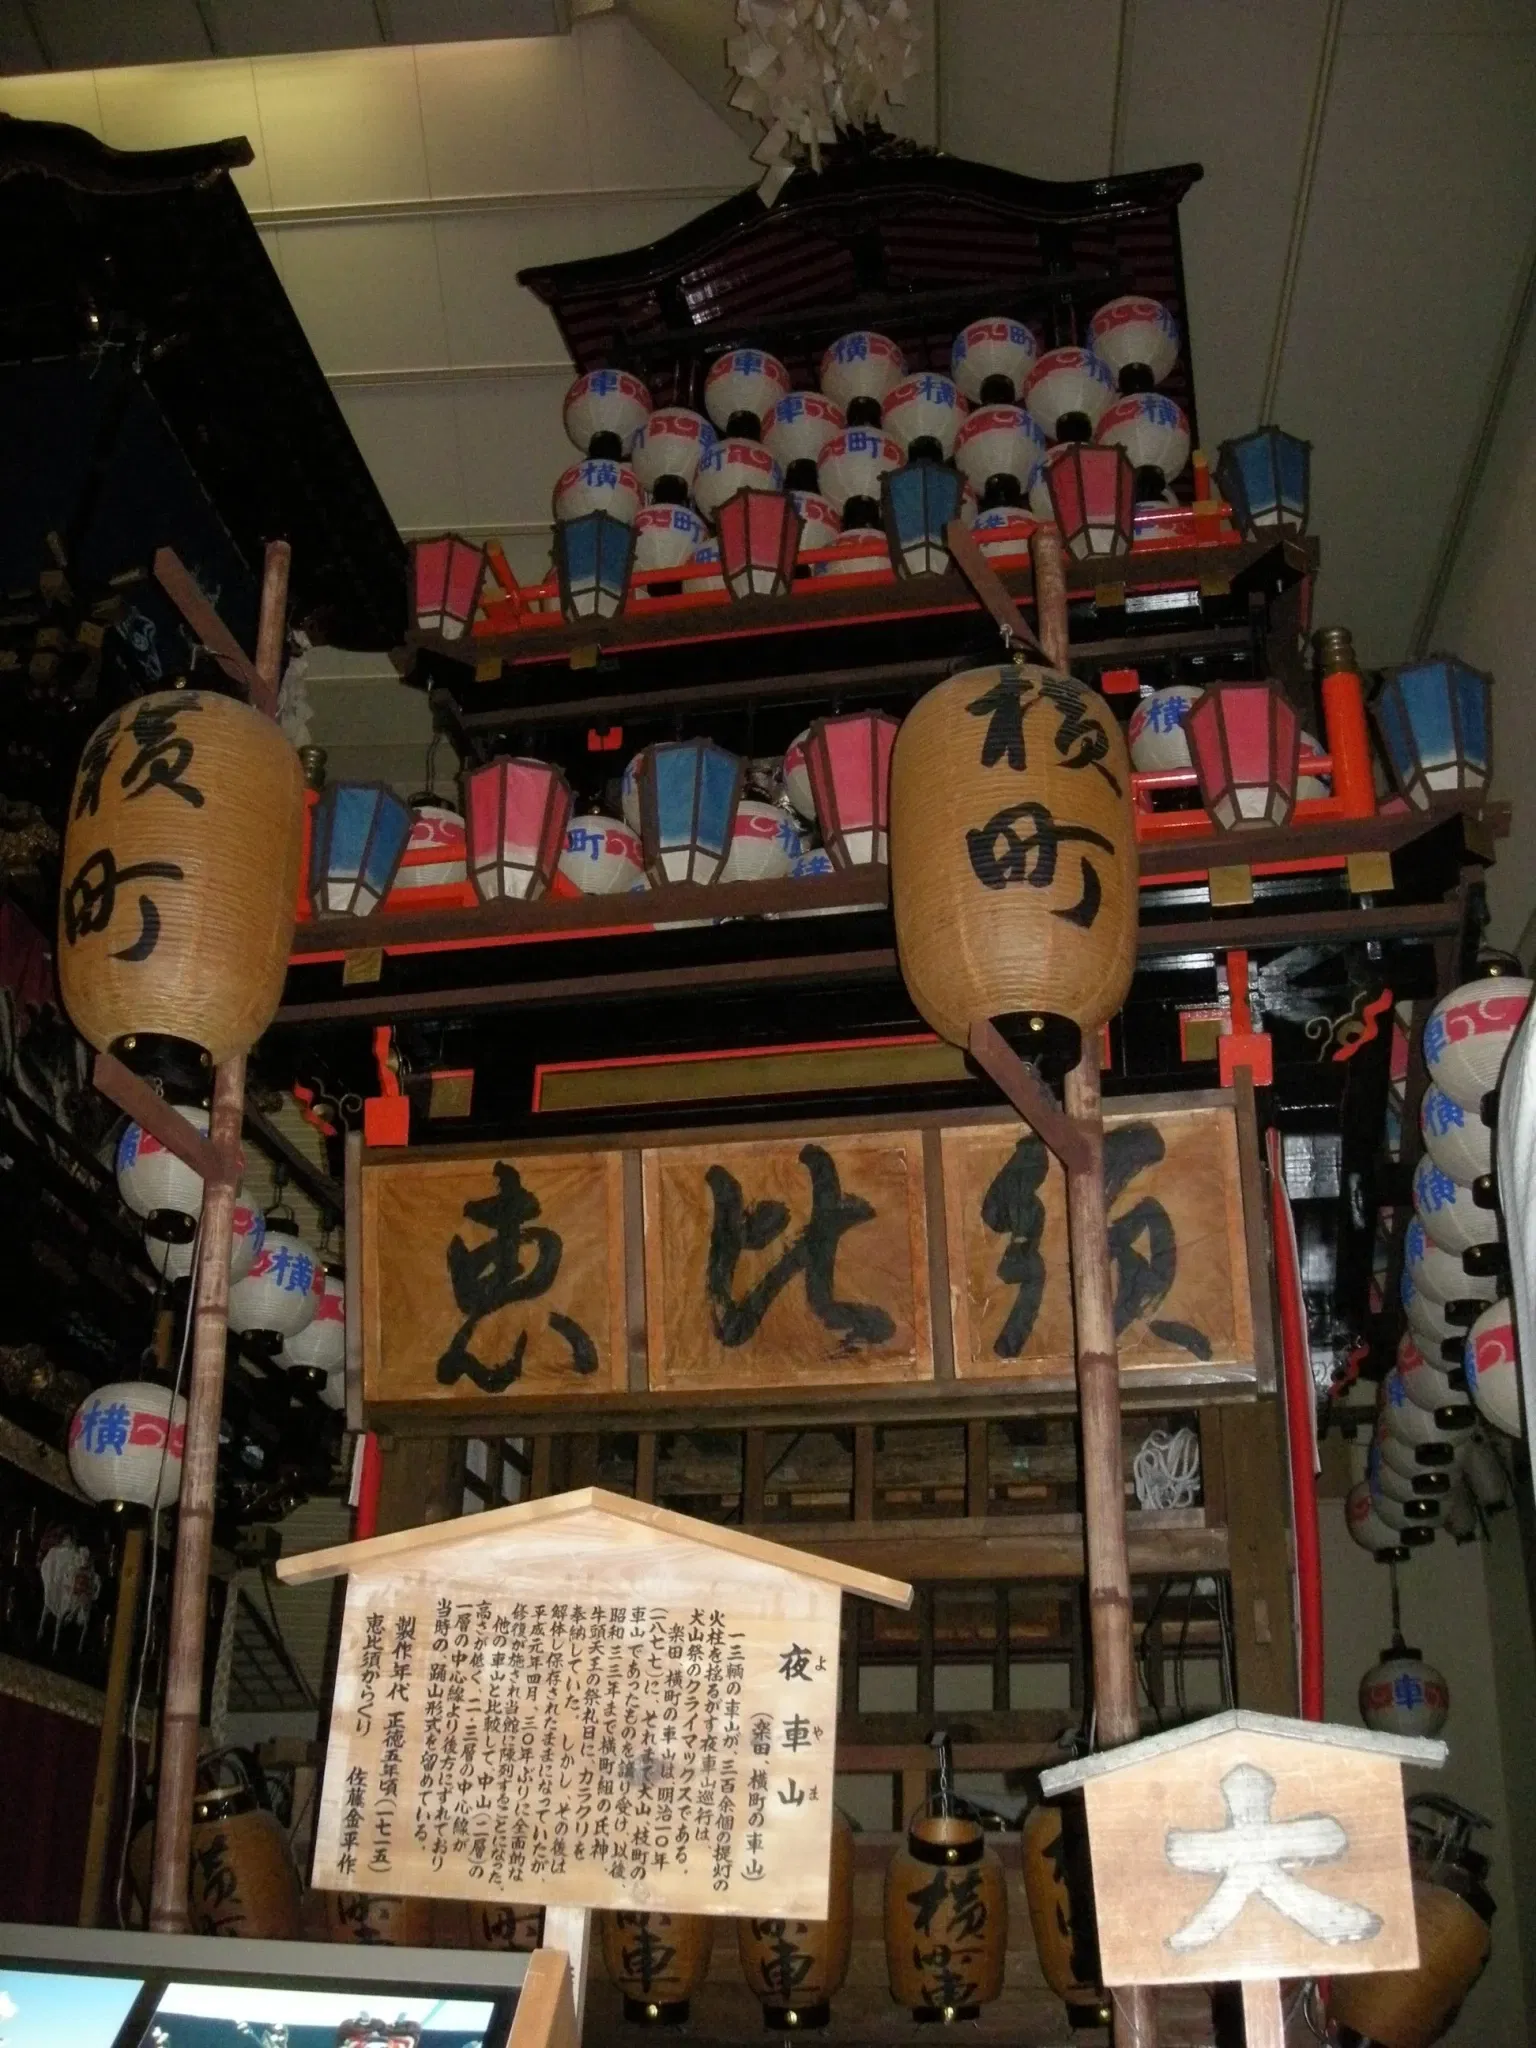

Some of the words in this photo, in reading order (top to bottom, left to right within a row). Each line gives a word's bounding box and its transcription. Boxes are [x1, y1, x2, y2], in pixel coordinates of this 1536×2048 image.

[848, 432, 882, 459] 町
[580, 463, 618, 490] 横
[673, 511, 704, 544] 町
[567, 828, 604, 861] 町
[270, 1246, 315, 1297] 横
[81, 1402, 132, 1456] 横
[356, 1612, 386, 1737] 恵比須からくり
[386, 1615, 416, 1702] 製作年代
[778, 1642, 813, 1807] 夜車山
[336, 1765, 368, 1876] 佐藤金平作
[1164, 1762, 1385, 1953] 大
